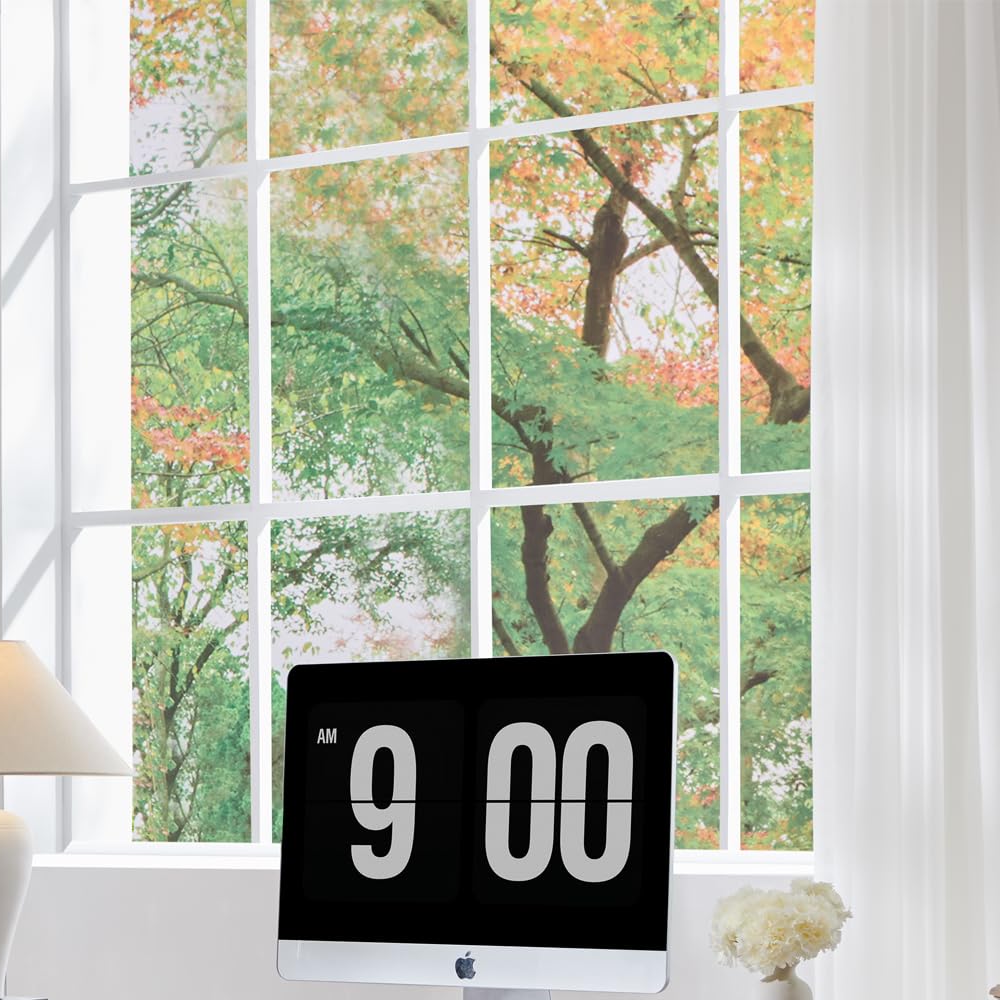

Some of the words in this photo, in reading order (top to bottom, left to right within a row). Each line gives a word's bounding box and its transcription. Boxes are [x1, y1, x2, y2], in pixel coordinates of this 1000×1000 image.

[316, 728, 338, 744] AM
[350, 724, 417, 880] 9
[485, 720, 634, 883] 00
